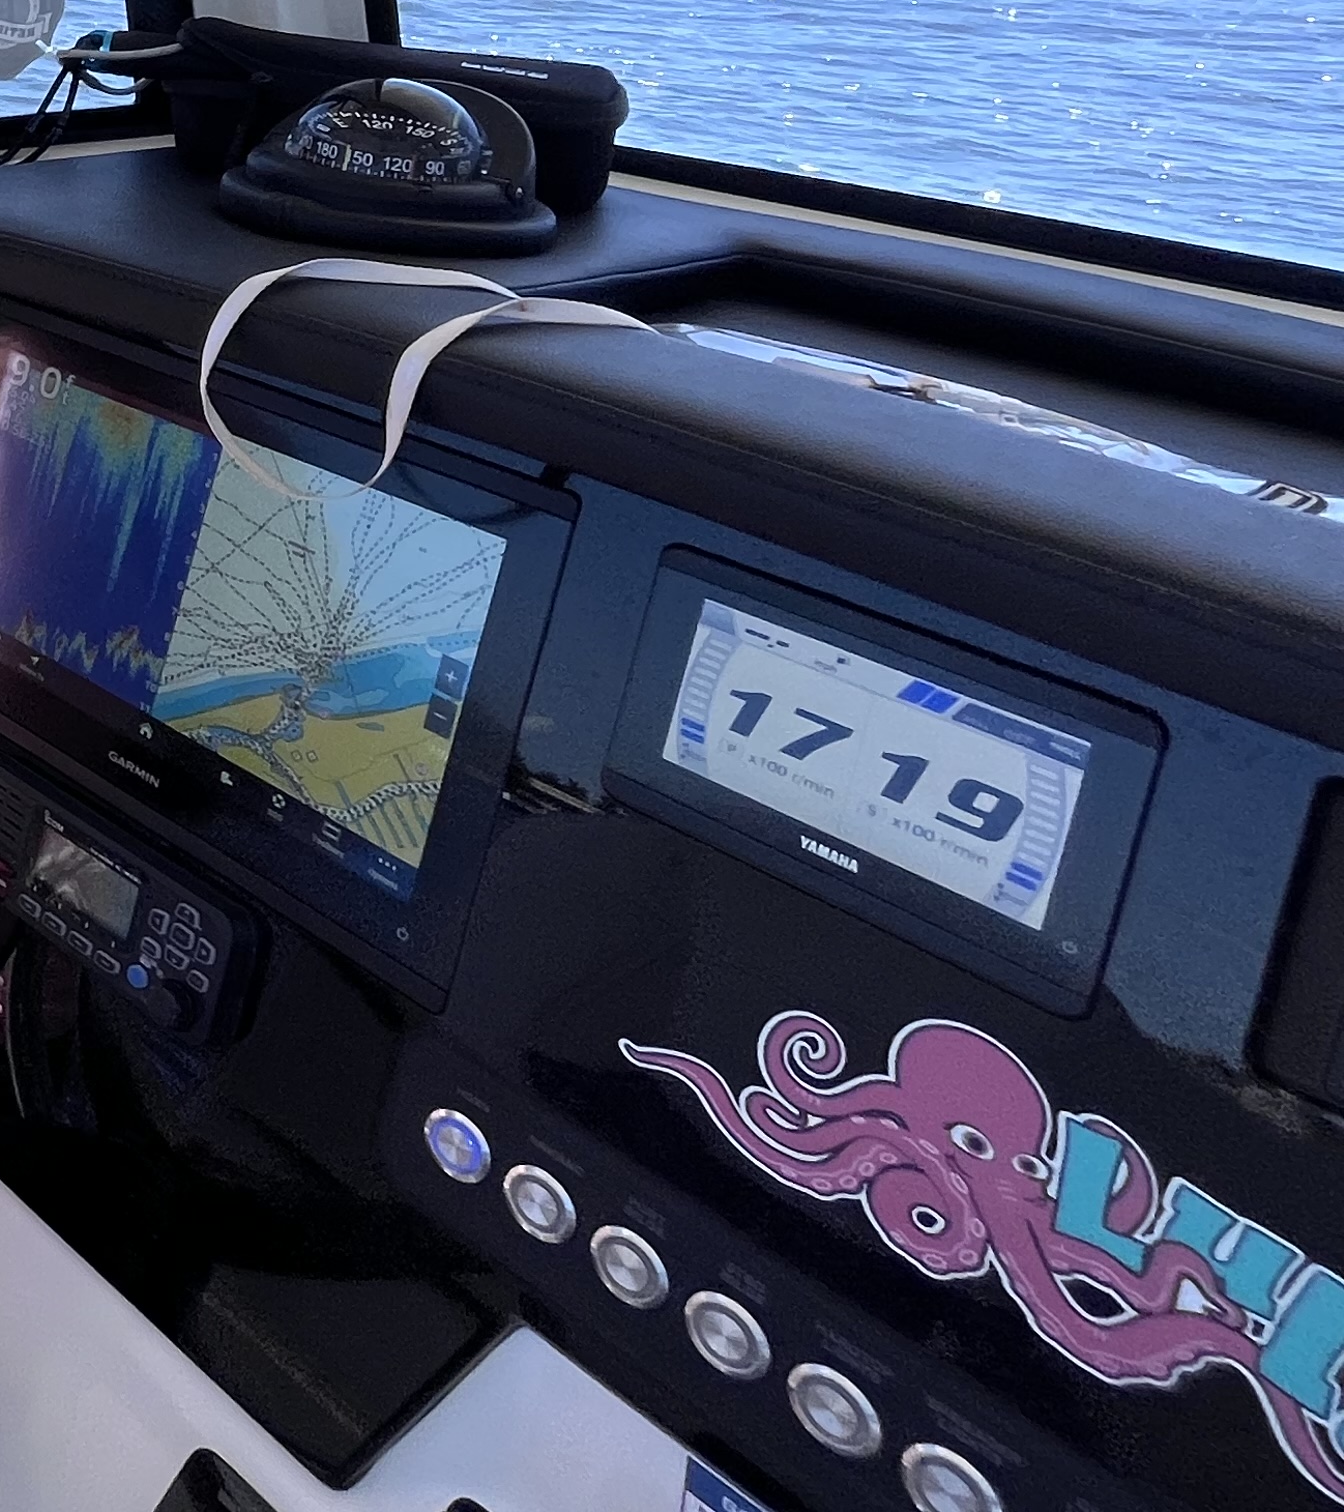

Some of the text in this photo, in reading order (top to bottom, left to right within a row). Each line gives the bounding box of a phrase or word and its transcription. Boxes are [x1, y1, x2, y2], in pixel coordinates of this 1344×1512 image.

[362, 119, 393, 130] 120
[405, 126, 435, 138] 150
[316, 141, 338, 159] 180
[383, 156, 413, 173] 120
[425, 160, 445, 176] 90
[107, 750, 161, 789] GARMIN
[729, 689, 1025, 842] 17 19
[799, 834, 858, 874] YAMAHA
